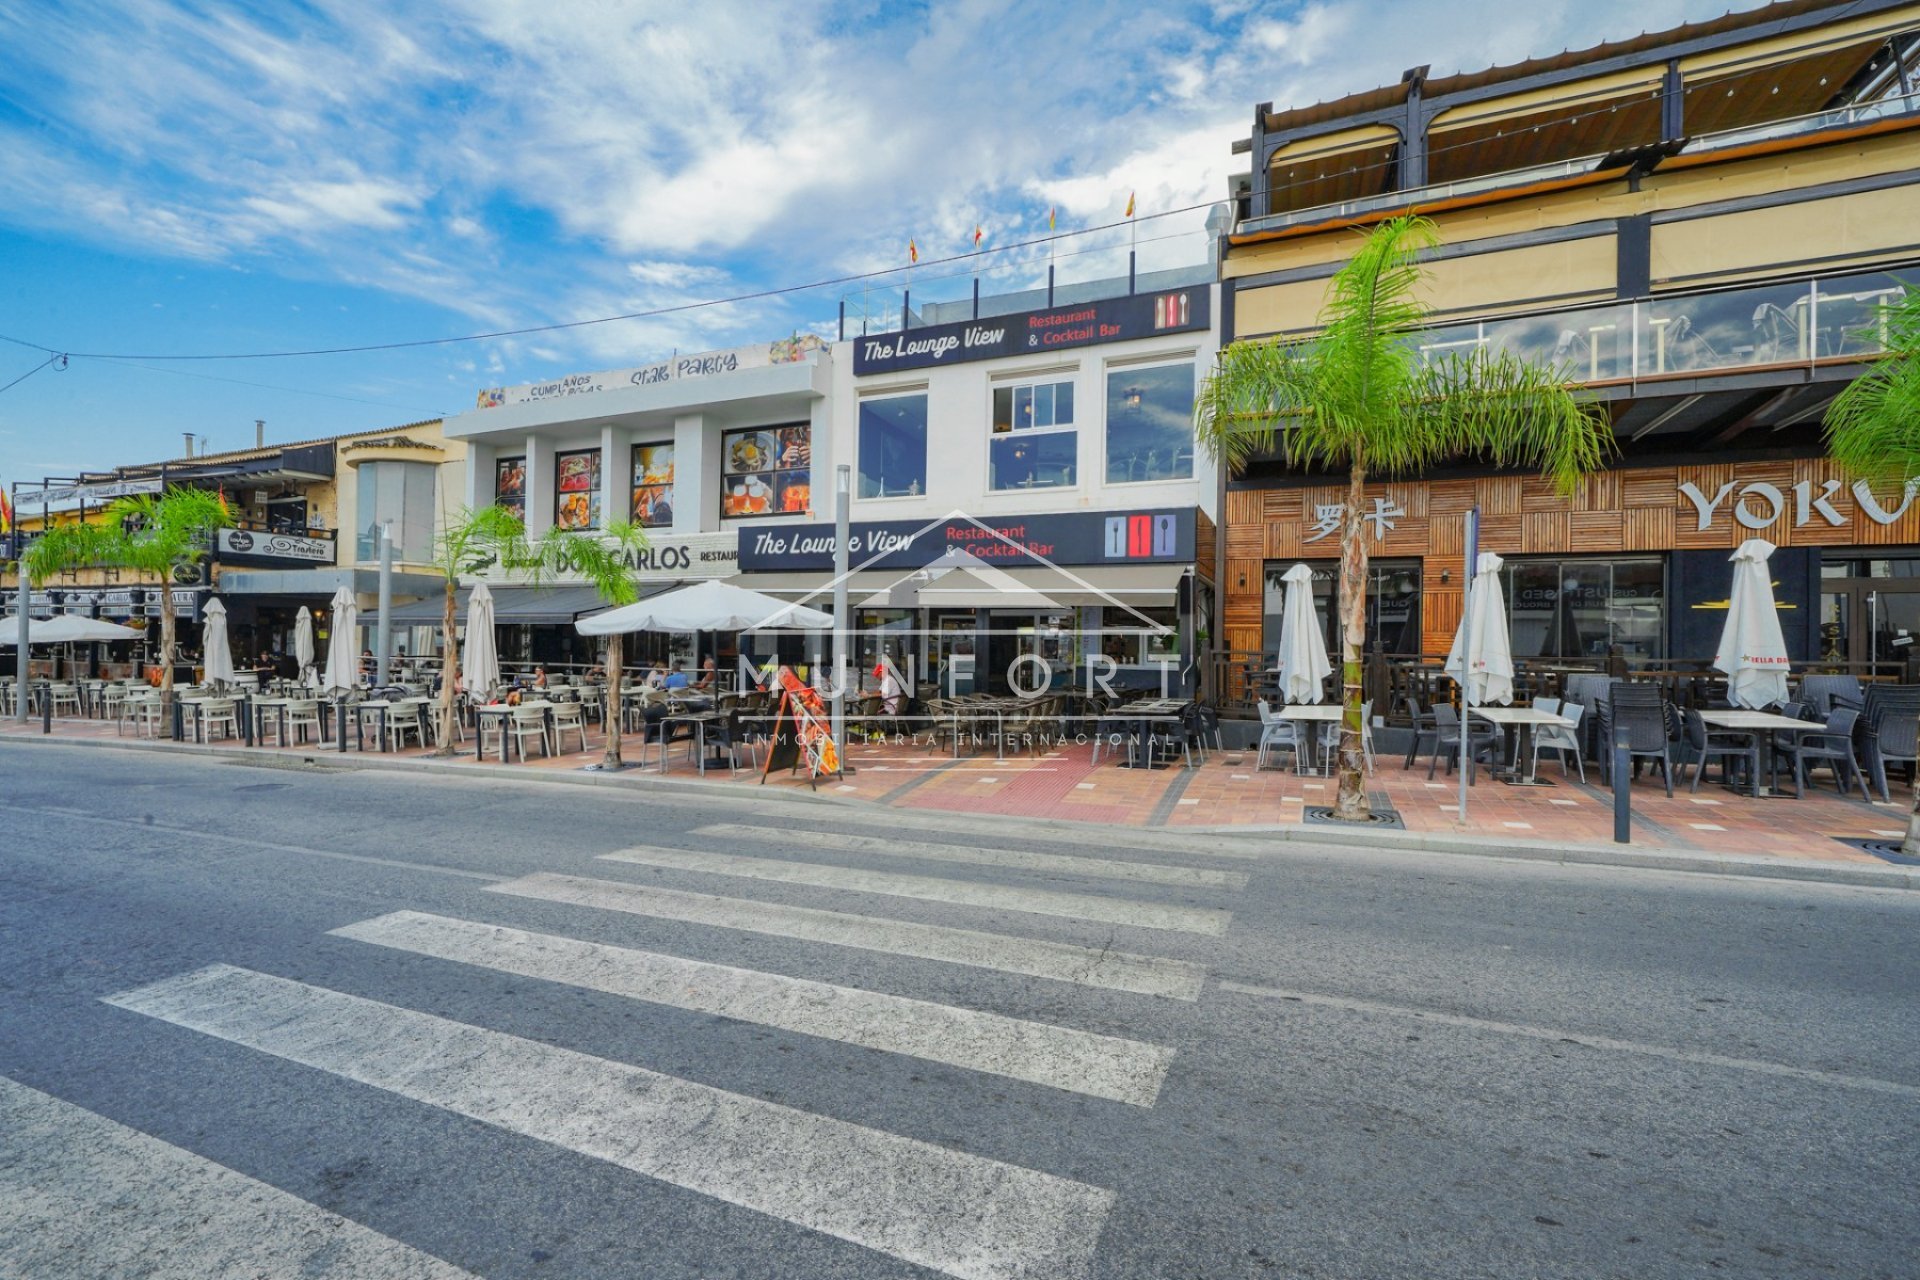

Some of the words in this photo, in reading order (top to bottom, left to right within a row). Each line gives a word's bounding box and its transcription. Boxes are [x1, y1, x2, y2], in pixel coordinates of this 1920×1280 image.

[1028, 308, 1096, 328] Restaurant
[864, 341, 894, 361] The
[895, 330, 960, 358] Lounge
[964, 326, 1005, 348] View
[1028, 334, 1038, 346] &
[1043, 327, 1094, 345] Cocktail
[1100, 322, 1121, 337] Bar
[946, 524, 1025, 541] Restaurant
[610, 545, 690, 571] CARLOS
[755, 533, 786, 555] The
[788, 532, 862, 562] Loune
[867, 530, 915, 552] View
[945, 543, 956, 558] &
[965, 541, 1023, 558] Cocktail
[1029, 542, 1055, 557] Bar
